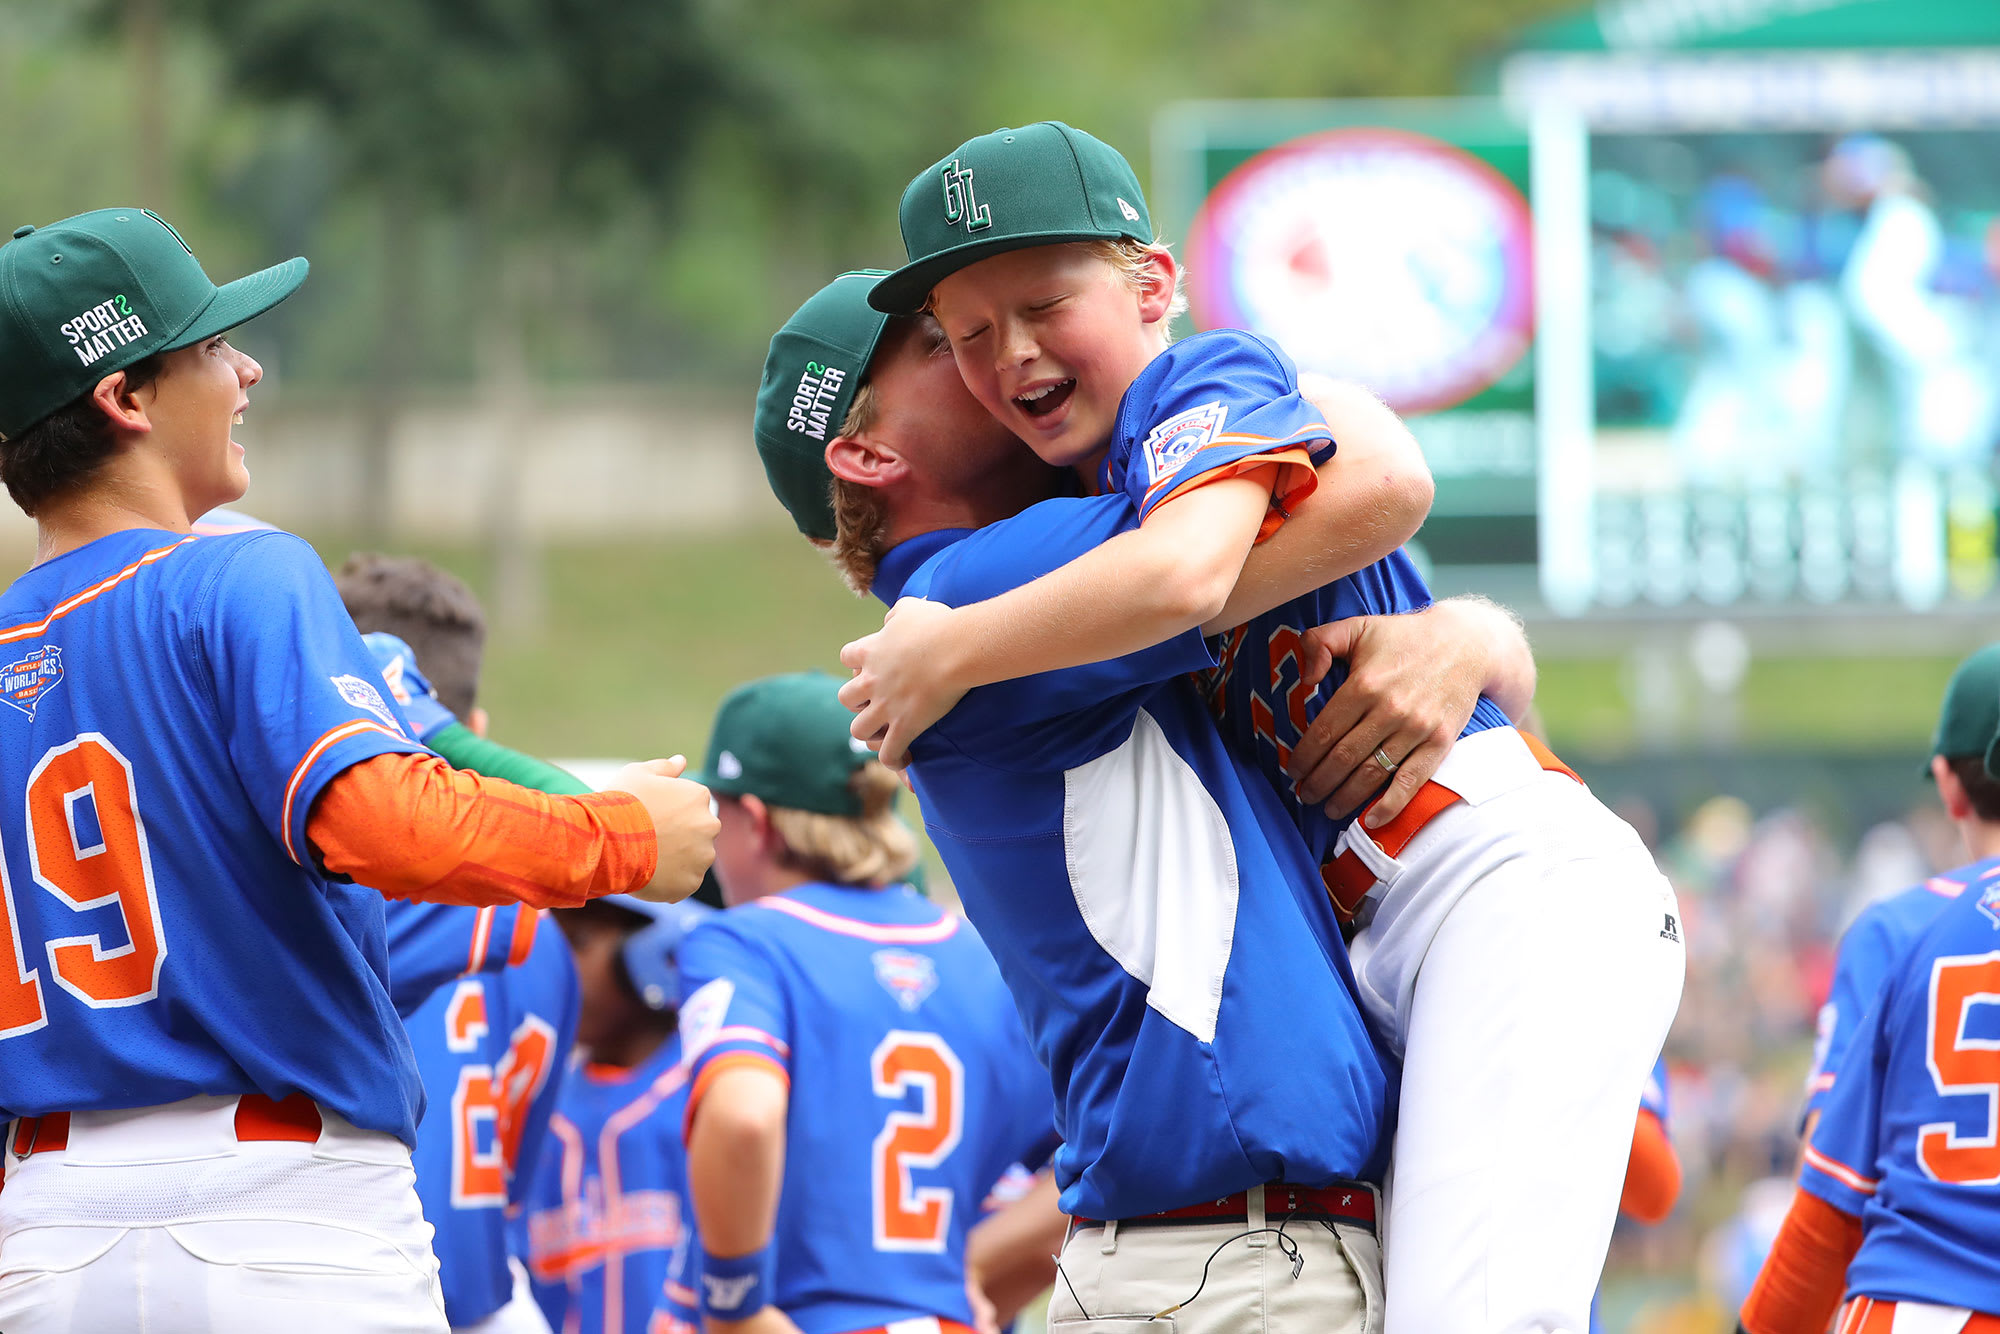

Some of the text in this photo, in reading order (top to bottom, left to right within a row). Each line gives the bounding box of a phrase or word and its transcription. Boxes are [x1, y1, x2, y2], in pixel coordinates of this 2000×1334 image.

[940, 159, 993, 234] GL
[73, 314, 149, 367] MATTER
[805, 367, 846, 440] MATTER
[5, 672, 37, 692] WORLD
[0, 732, 168, 1040] 9
[1664, 913, 1676, 934] R
[1917, 951, 2000, 1187] 5
[871, 1029, 965, 1254] 2
